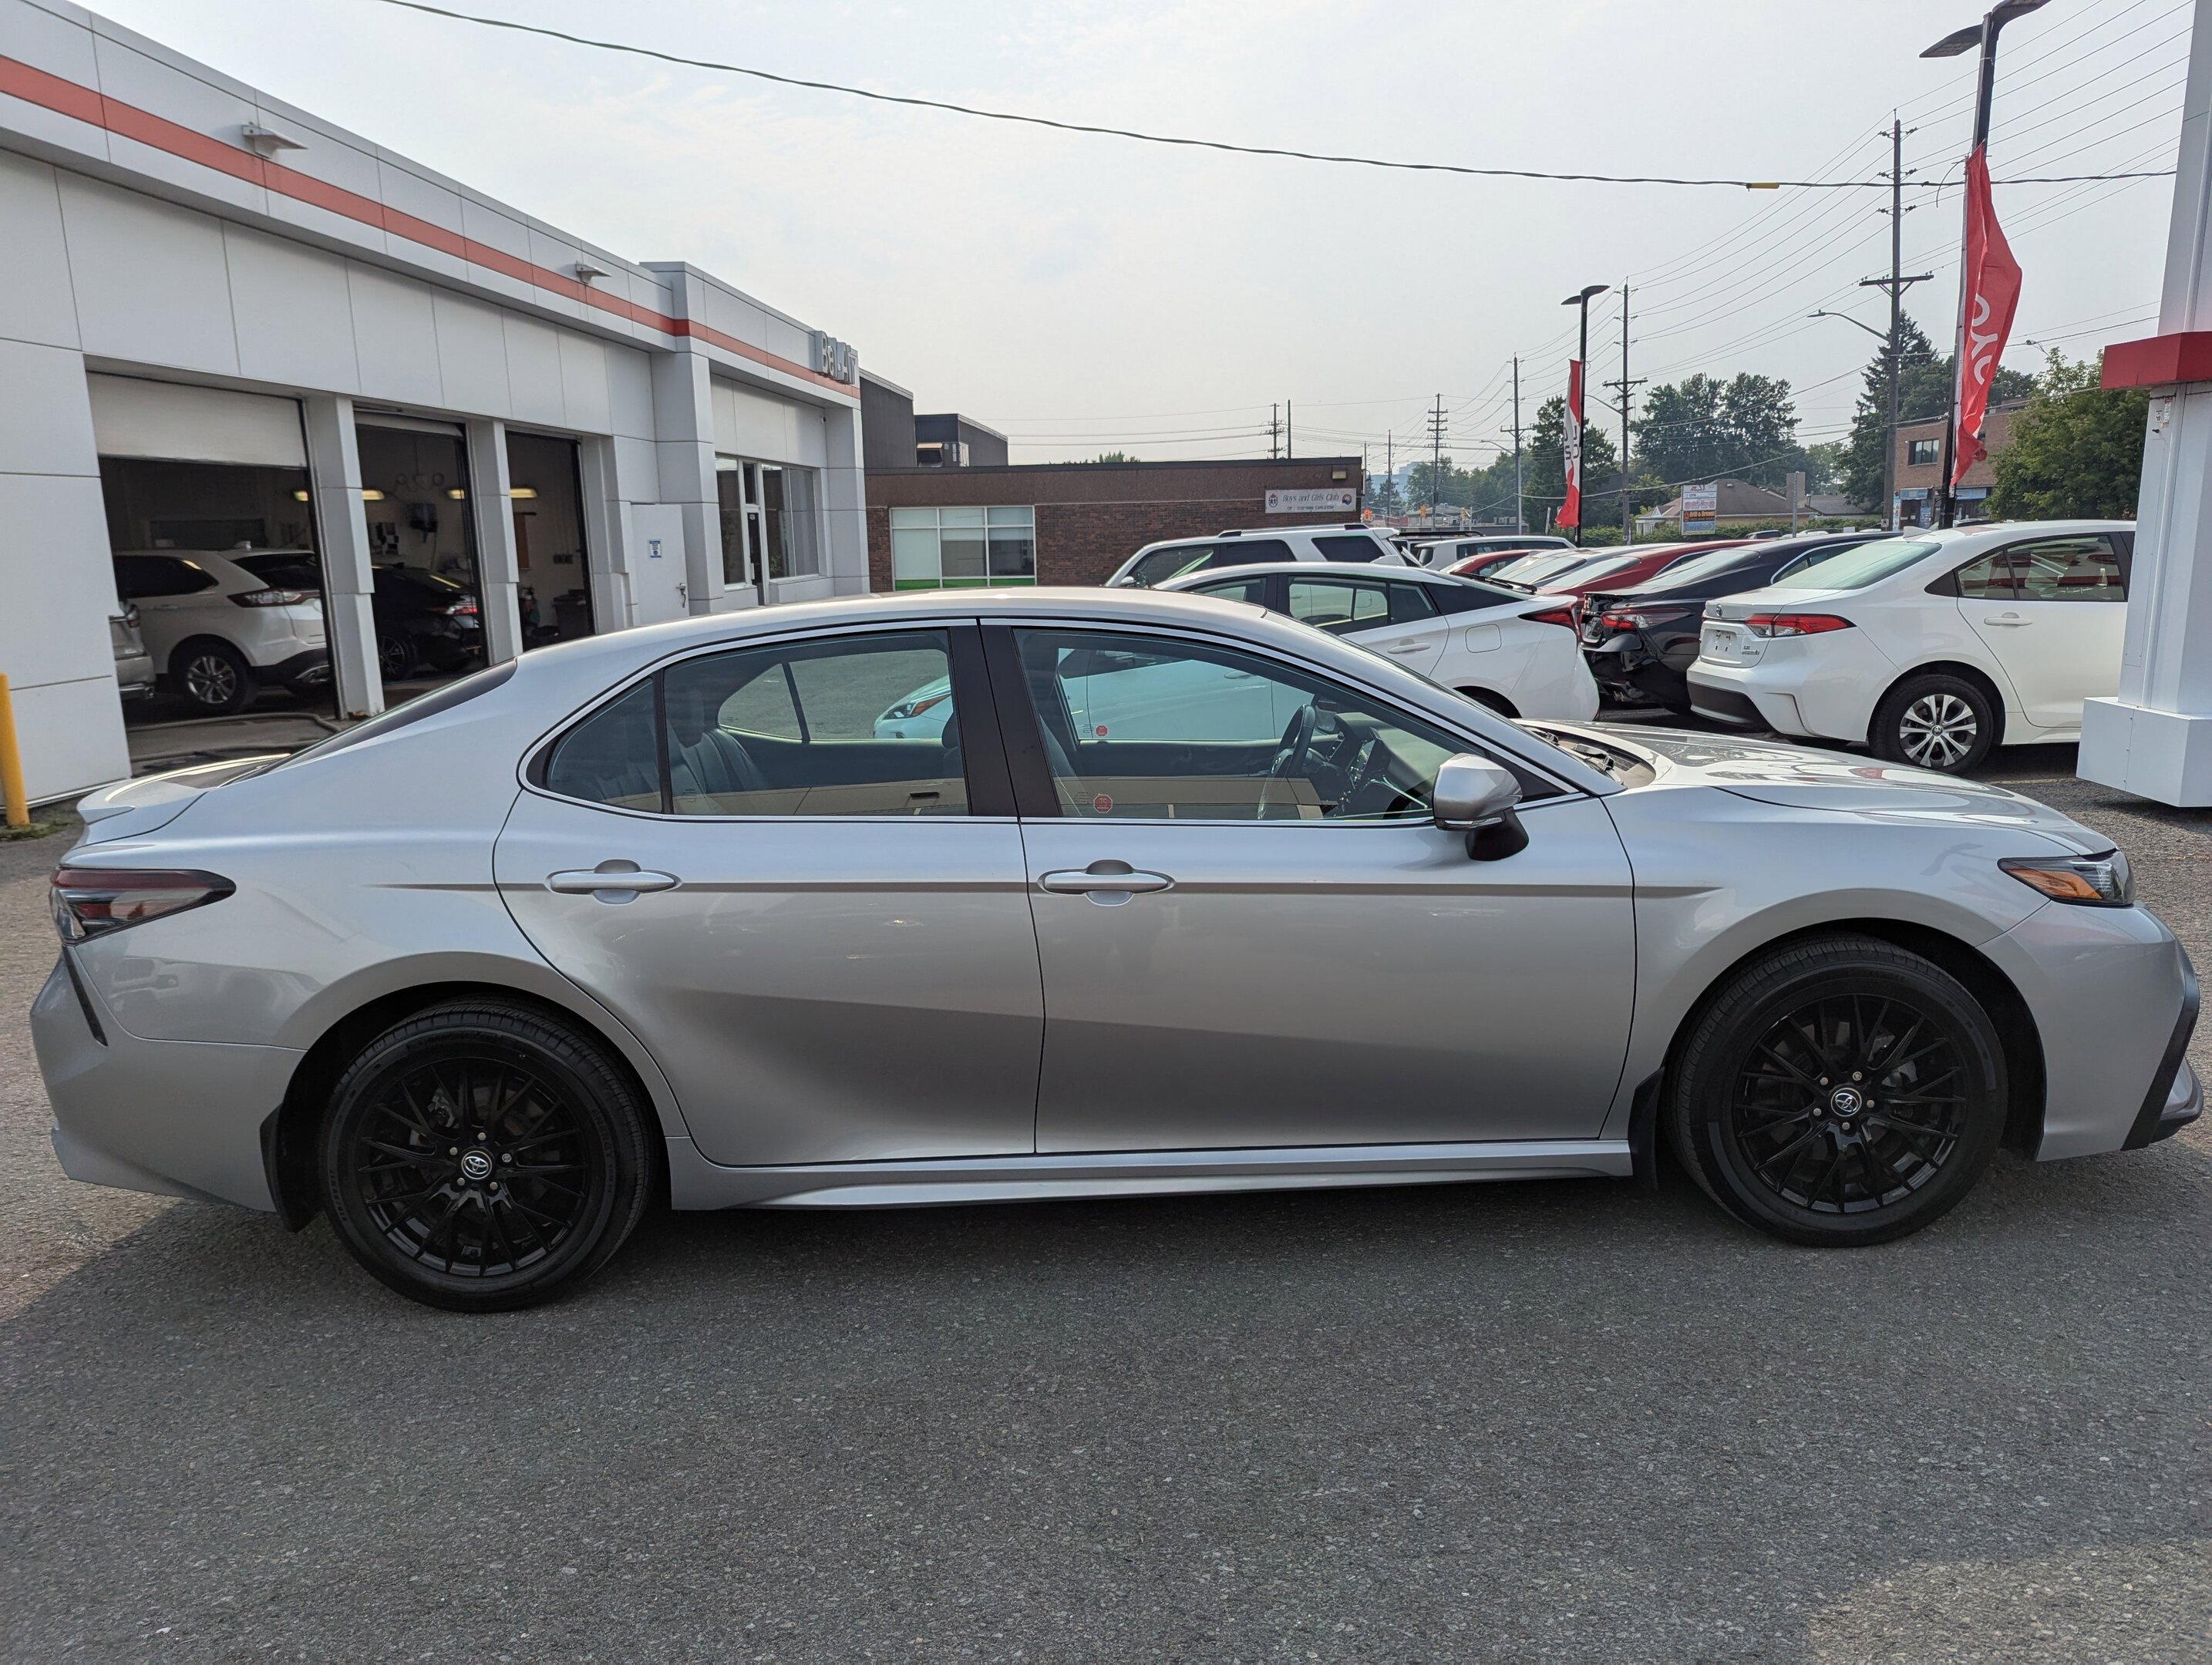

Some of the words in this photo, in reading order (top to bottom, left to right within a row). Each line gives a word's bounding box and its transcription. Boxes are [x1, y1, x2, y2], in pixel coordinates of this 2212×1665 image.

[816, 331, 856, 385] Bel-Air
[1282, 494, 1297, 503] Boys
[1325, 493, 1339, 501] Club
